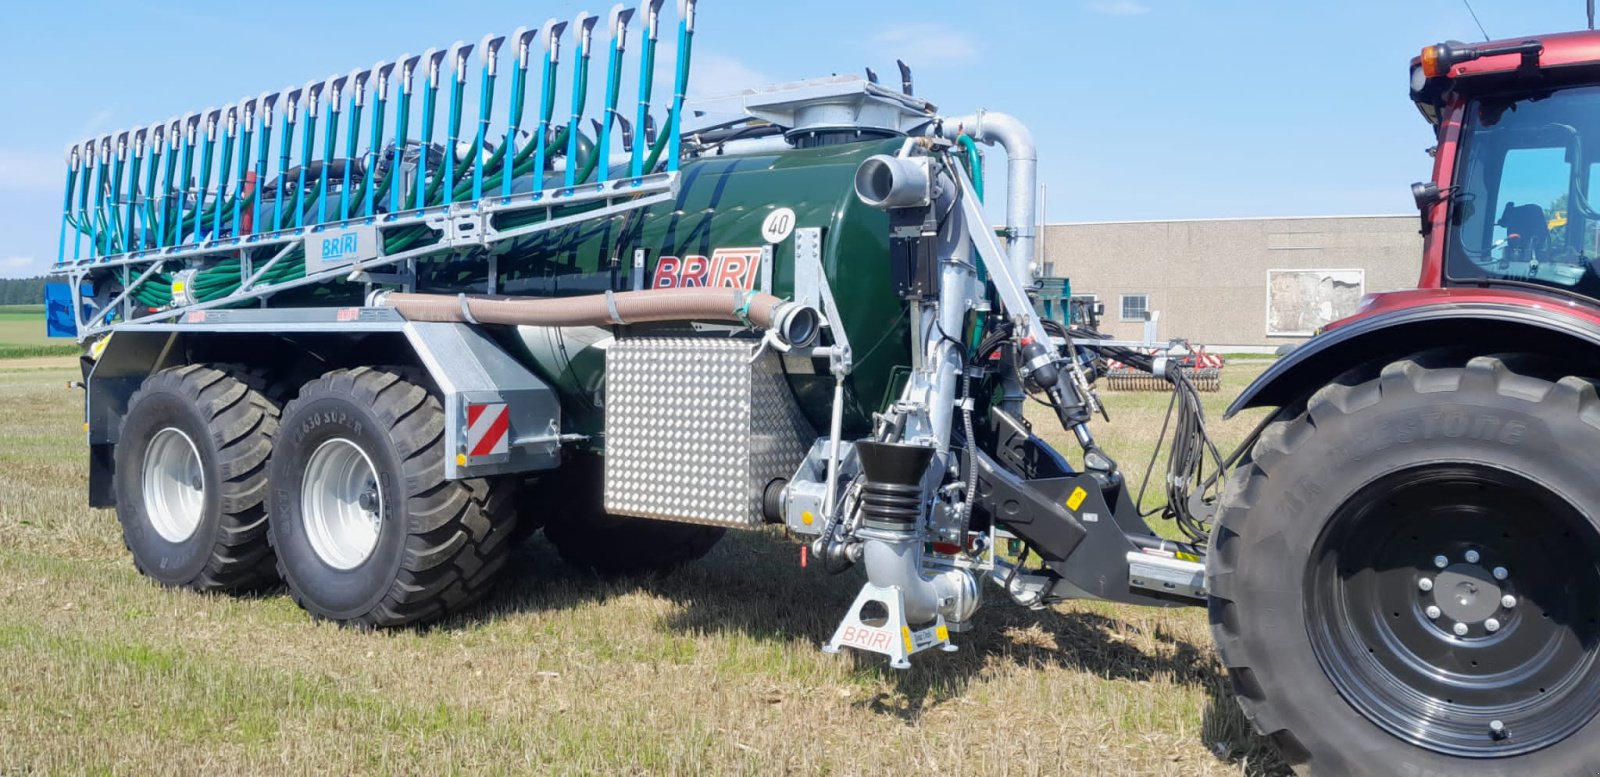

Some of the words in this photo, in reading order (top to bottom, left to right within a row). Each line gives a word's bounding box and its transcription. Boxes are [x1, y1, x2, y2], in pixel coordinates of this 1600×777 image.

[768, 213, 789, 235] 40
[322, 232, 358, 259] BRIRI
[653, 248, 762, 290] BRIRI
[302, 410, 321, 434] 630
[843, 626, 893, 650] BRIRI
